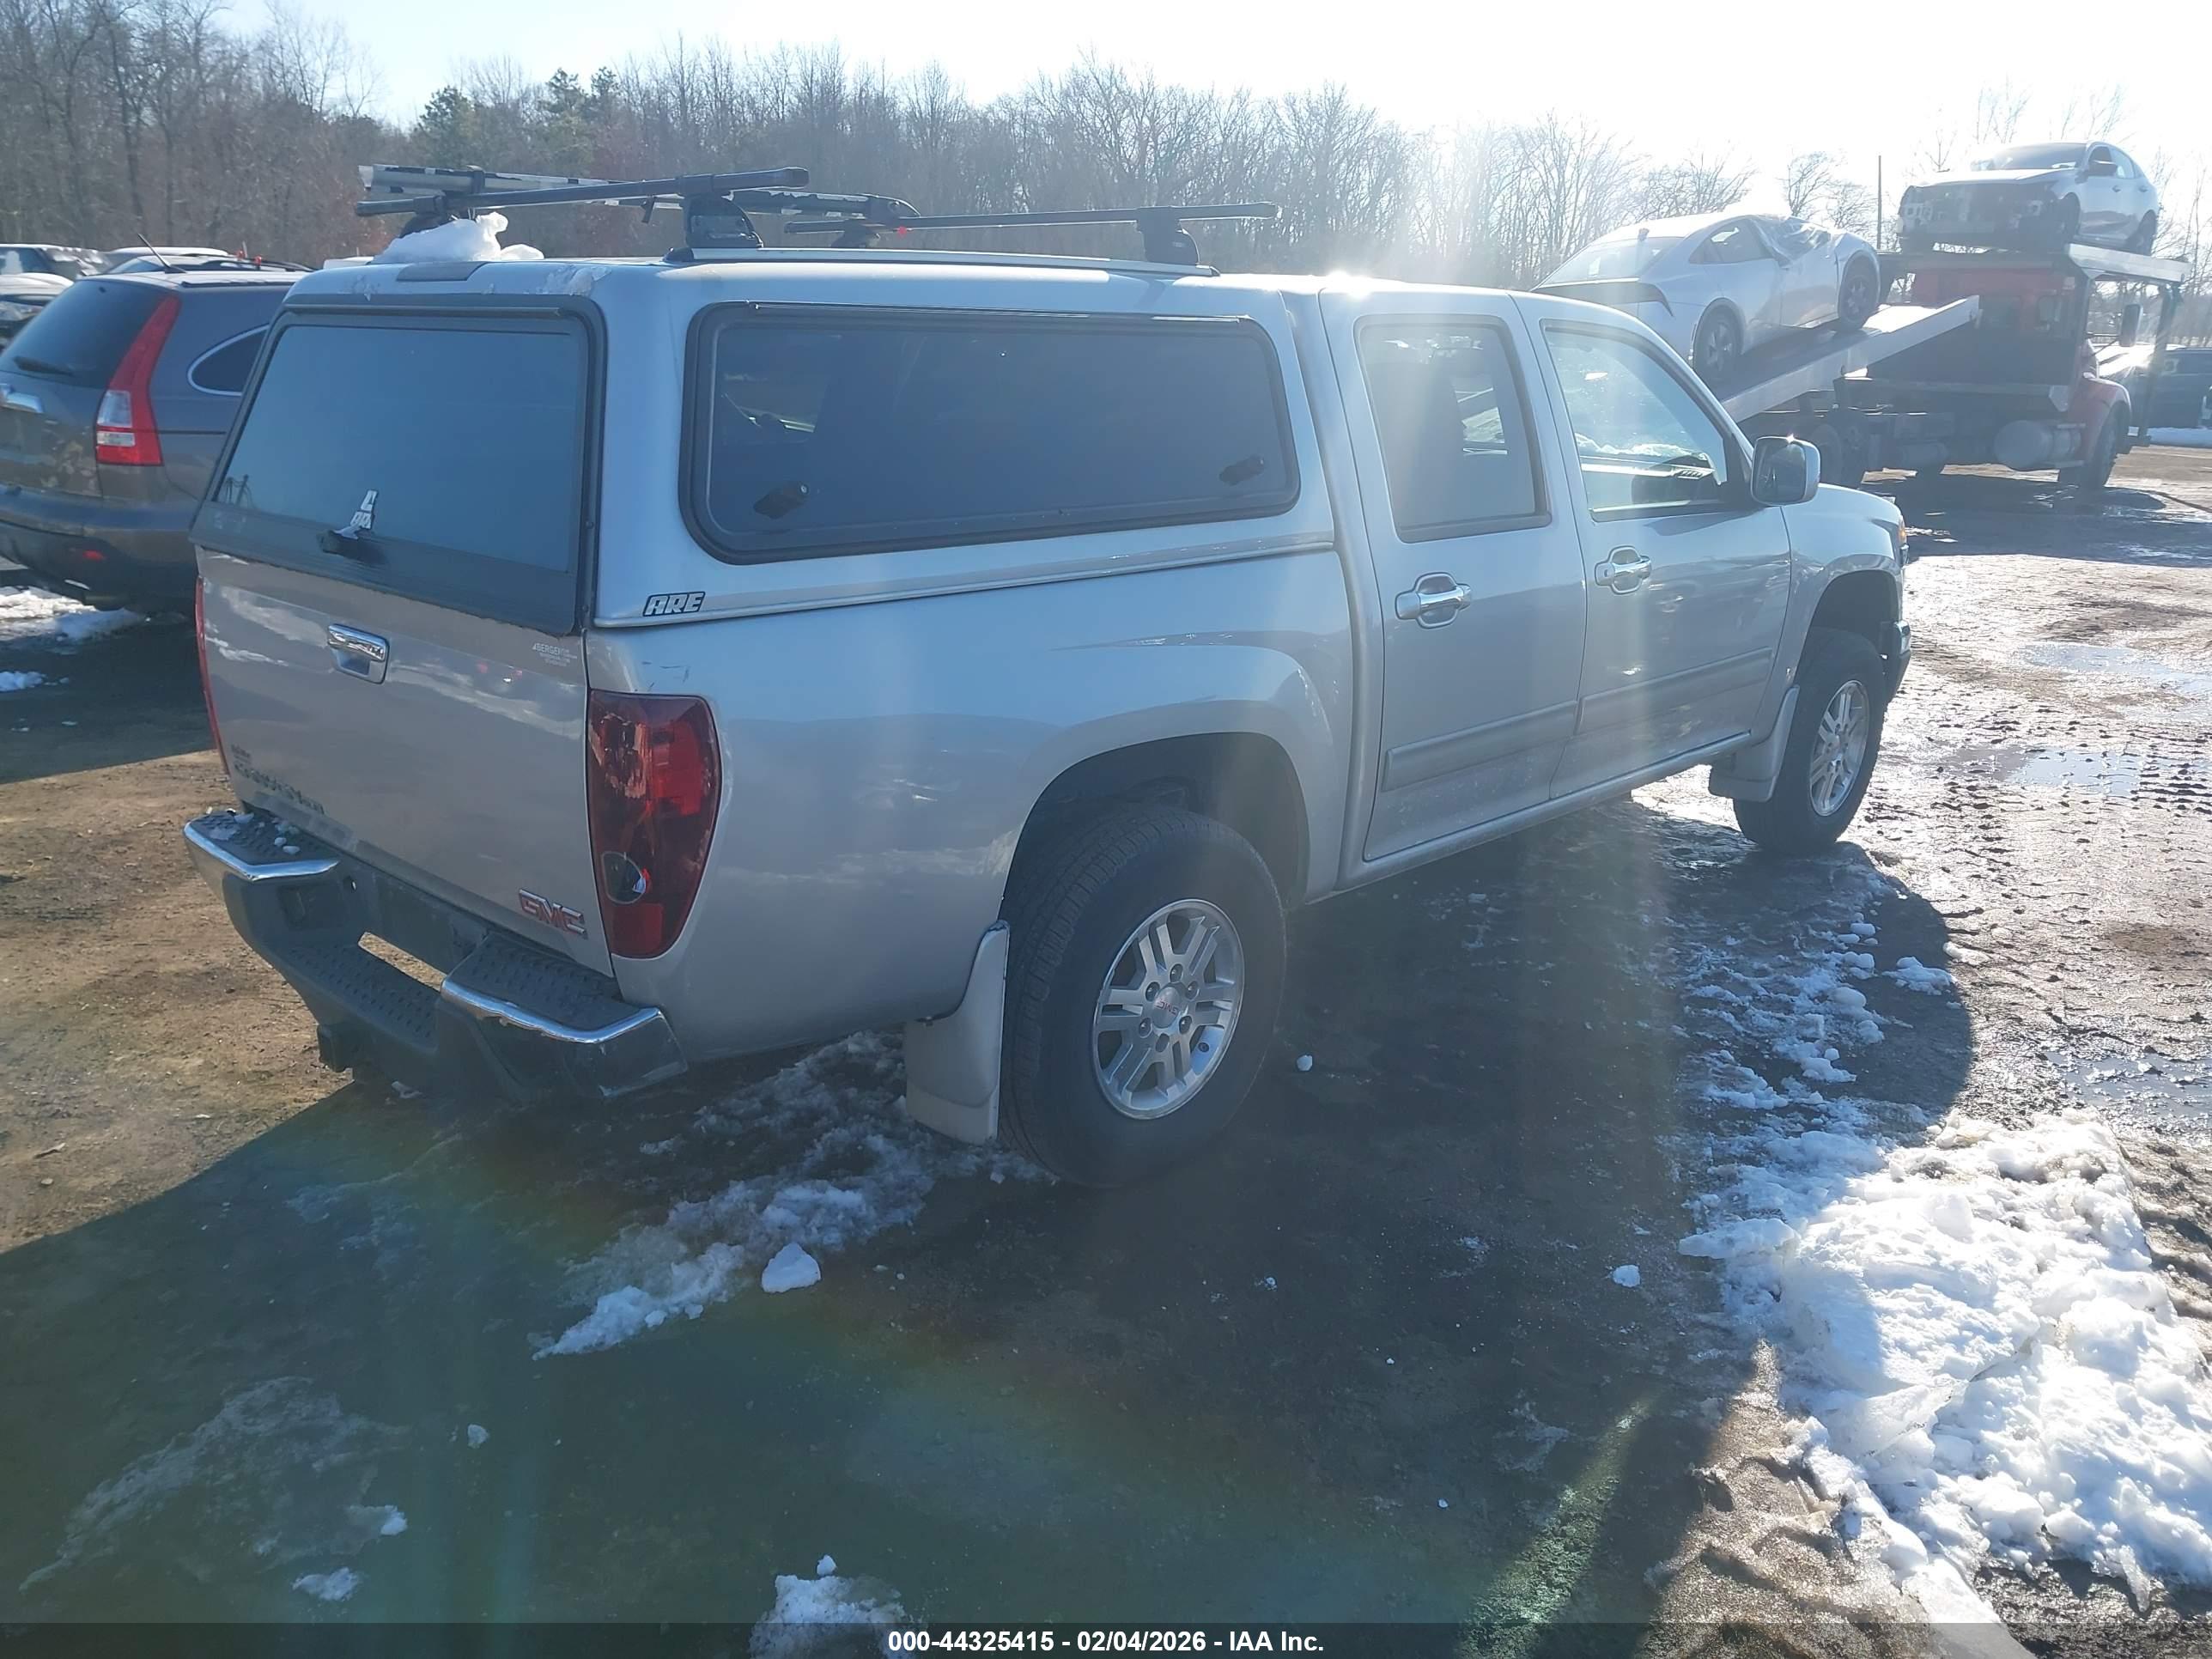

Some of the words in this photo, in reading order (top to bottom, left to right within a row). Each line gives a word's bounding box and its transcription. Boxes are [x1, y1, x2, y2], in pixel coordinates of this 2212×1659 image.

[642, 591, 705, 617] ARE
[520, 889, 586, 935] GMC
[1155, 1000, 1178, 1016] GMC
